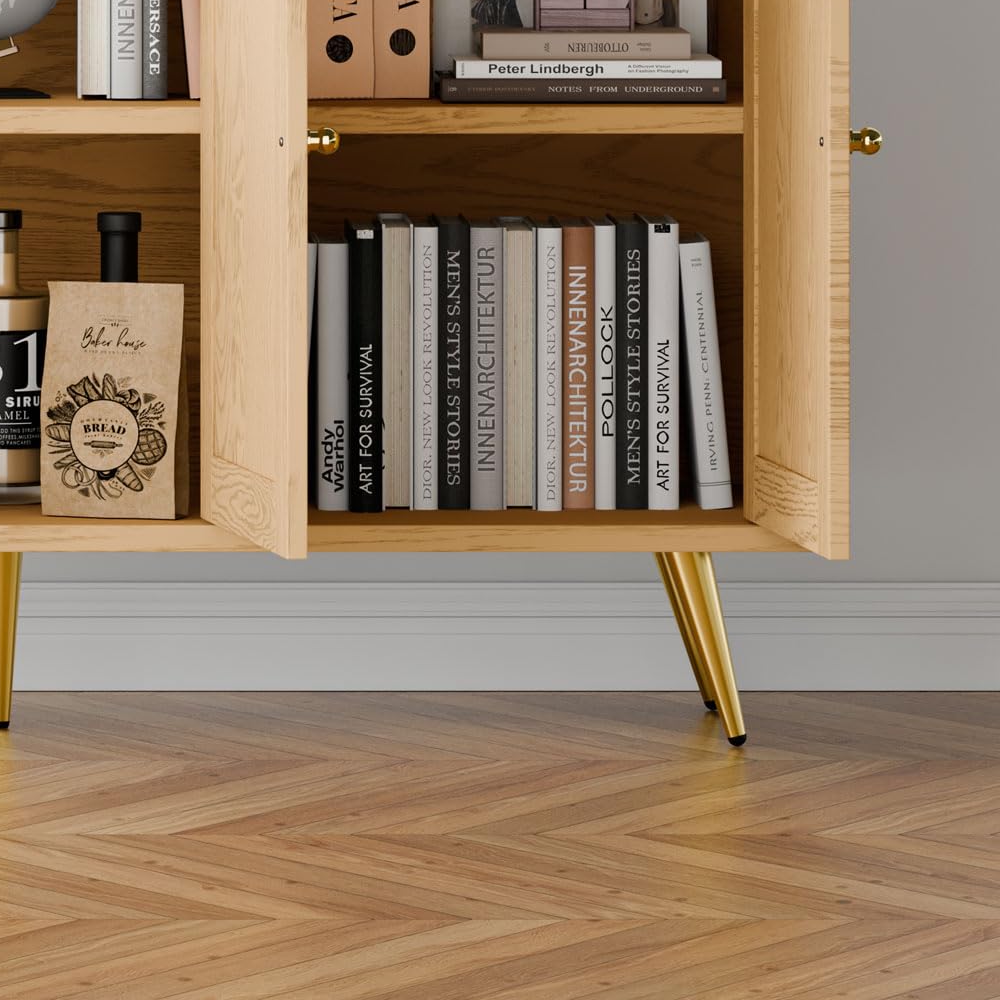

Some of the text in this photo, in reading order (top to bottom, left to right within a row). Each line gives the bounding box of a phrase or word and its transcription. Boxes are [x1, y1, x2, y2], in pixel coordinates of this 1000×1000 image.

[488, 63, 604, 77] Peter Lindbergh
[567, 42, 629, 53] OTTOBEUREN
[548, 85, 703, 93] NOTES FROM UNDERGROUND
[422, 244, 432, 353] REVOLUTION
[546, 245, 556, 354] REVOLUTION
[627, 248, 641, 341] STORIES
[81, 326, 148, 351] Baker house
[446, 321, 461, 390] STYLE
[477, 246, 496, 472] INNENARCHITEKTUR
[695, 290, 710, 374] CENTENNIAL
[5, 396, 40, 408] SIRU
[422, 360, 432, 408] LOOK
[546, 360, 556, 409] LOOK
[568, 265, 588, 493] INNENARCHITEKTUR
[600, 305, 615, 437] POLLOCK
[627, 344, 641, 414] STYLE
[83, 423, 126, 435] BREAD
[358, 343, 373, 495] ART FOR SURVIVAL
[422, 413, 432, 451] NEW
[446, 395, 461, 486] STORIES
[546, 413, 556, 451] NEW
[656, 338, 670, 491] ART FOR SURVIVAL
[705, 421, 718, 472] IRVING
[321, 428, 336, 484] Andy
[333, 420, 345, 493] Warhol
